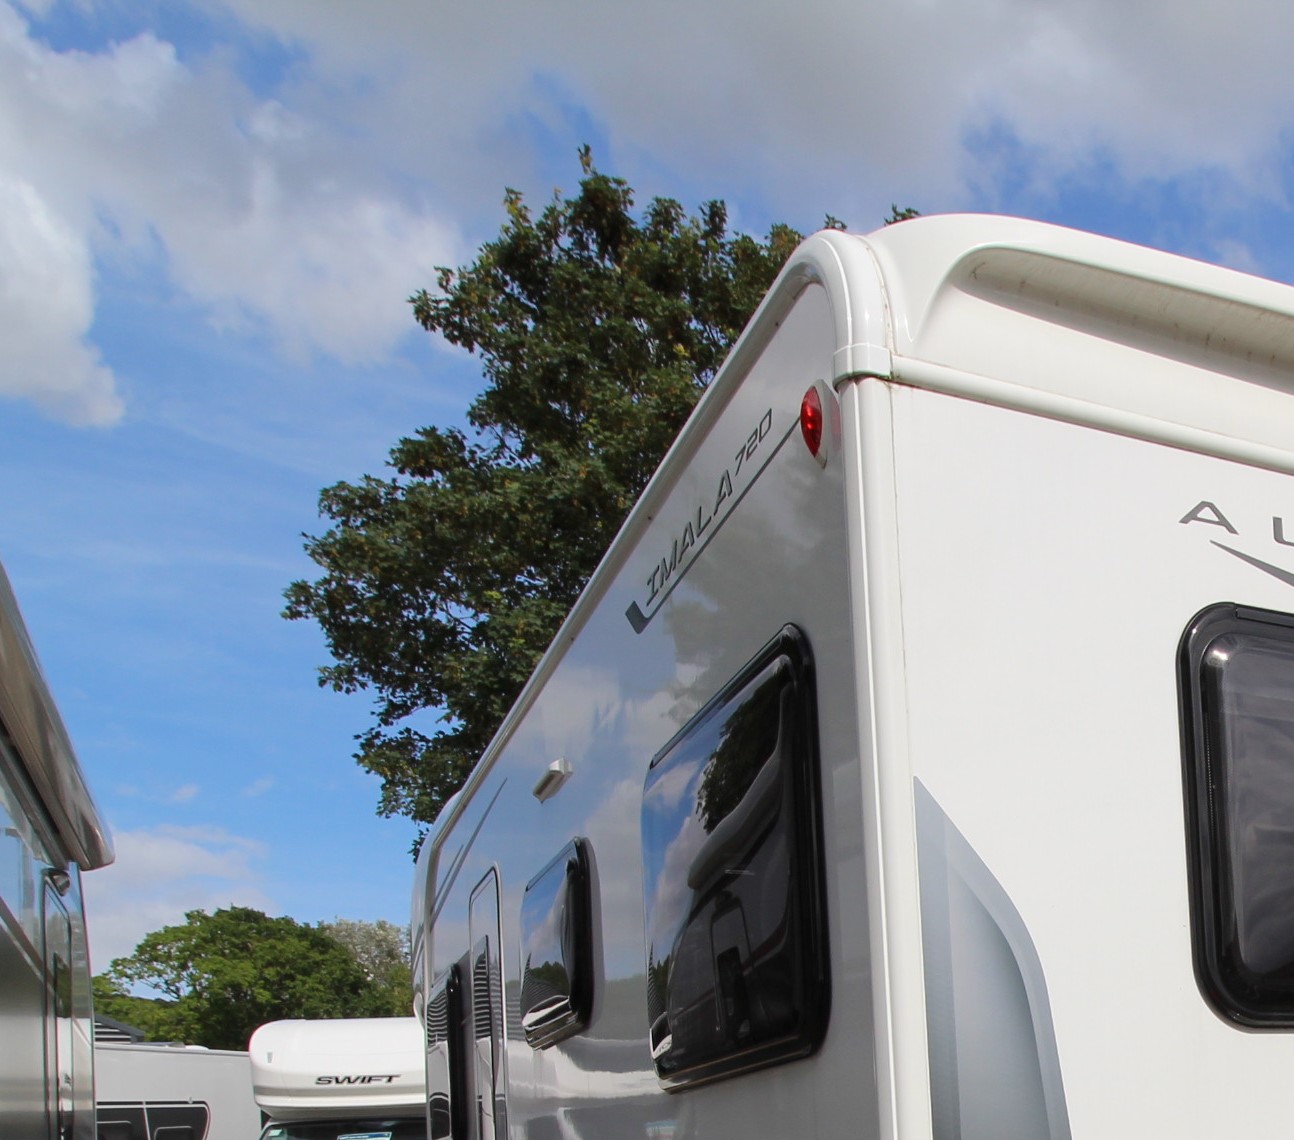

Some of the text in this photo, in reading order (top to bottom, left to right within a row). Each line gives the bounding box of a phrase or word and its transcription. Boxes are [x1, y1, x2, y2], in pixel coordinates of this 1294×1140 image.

[646, 407, 773, 607] IMALA 720
[315, 1073, 402, 1086] SWIFT
